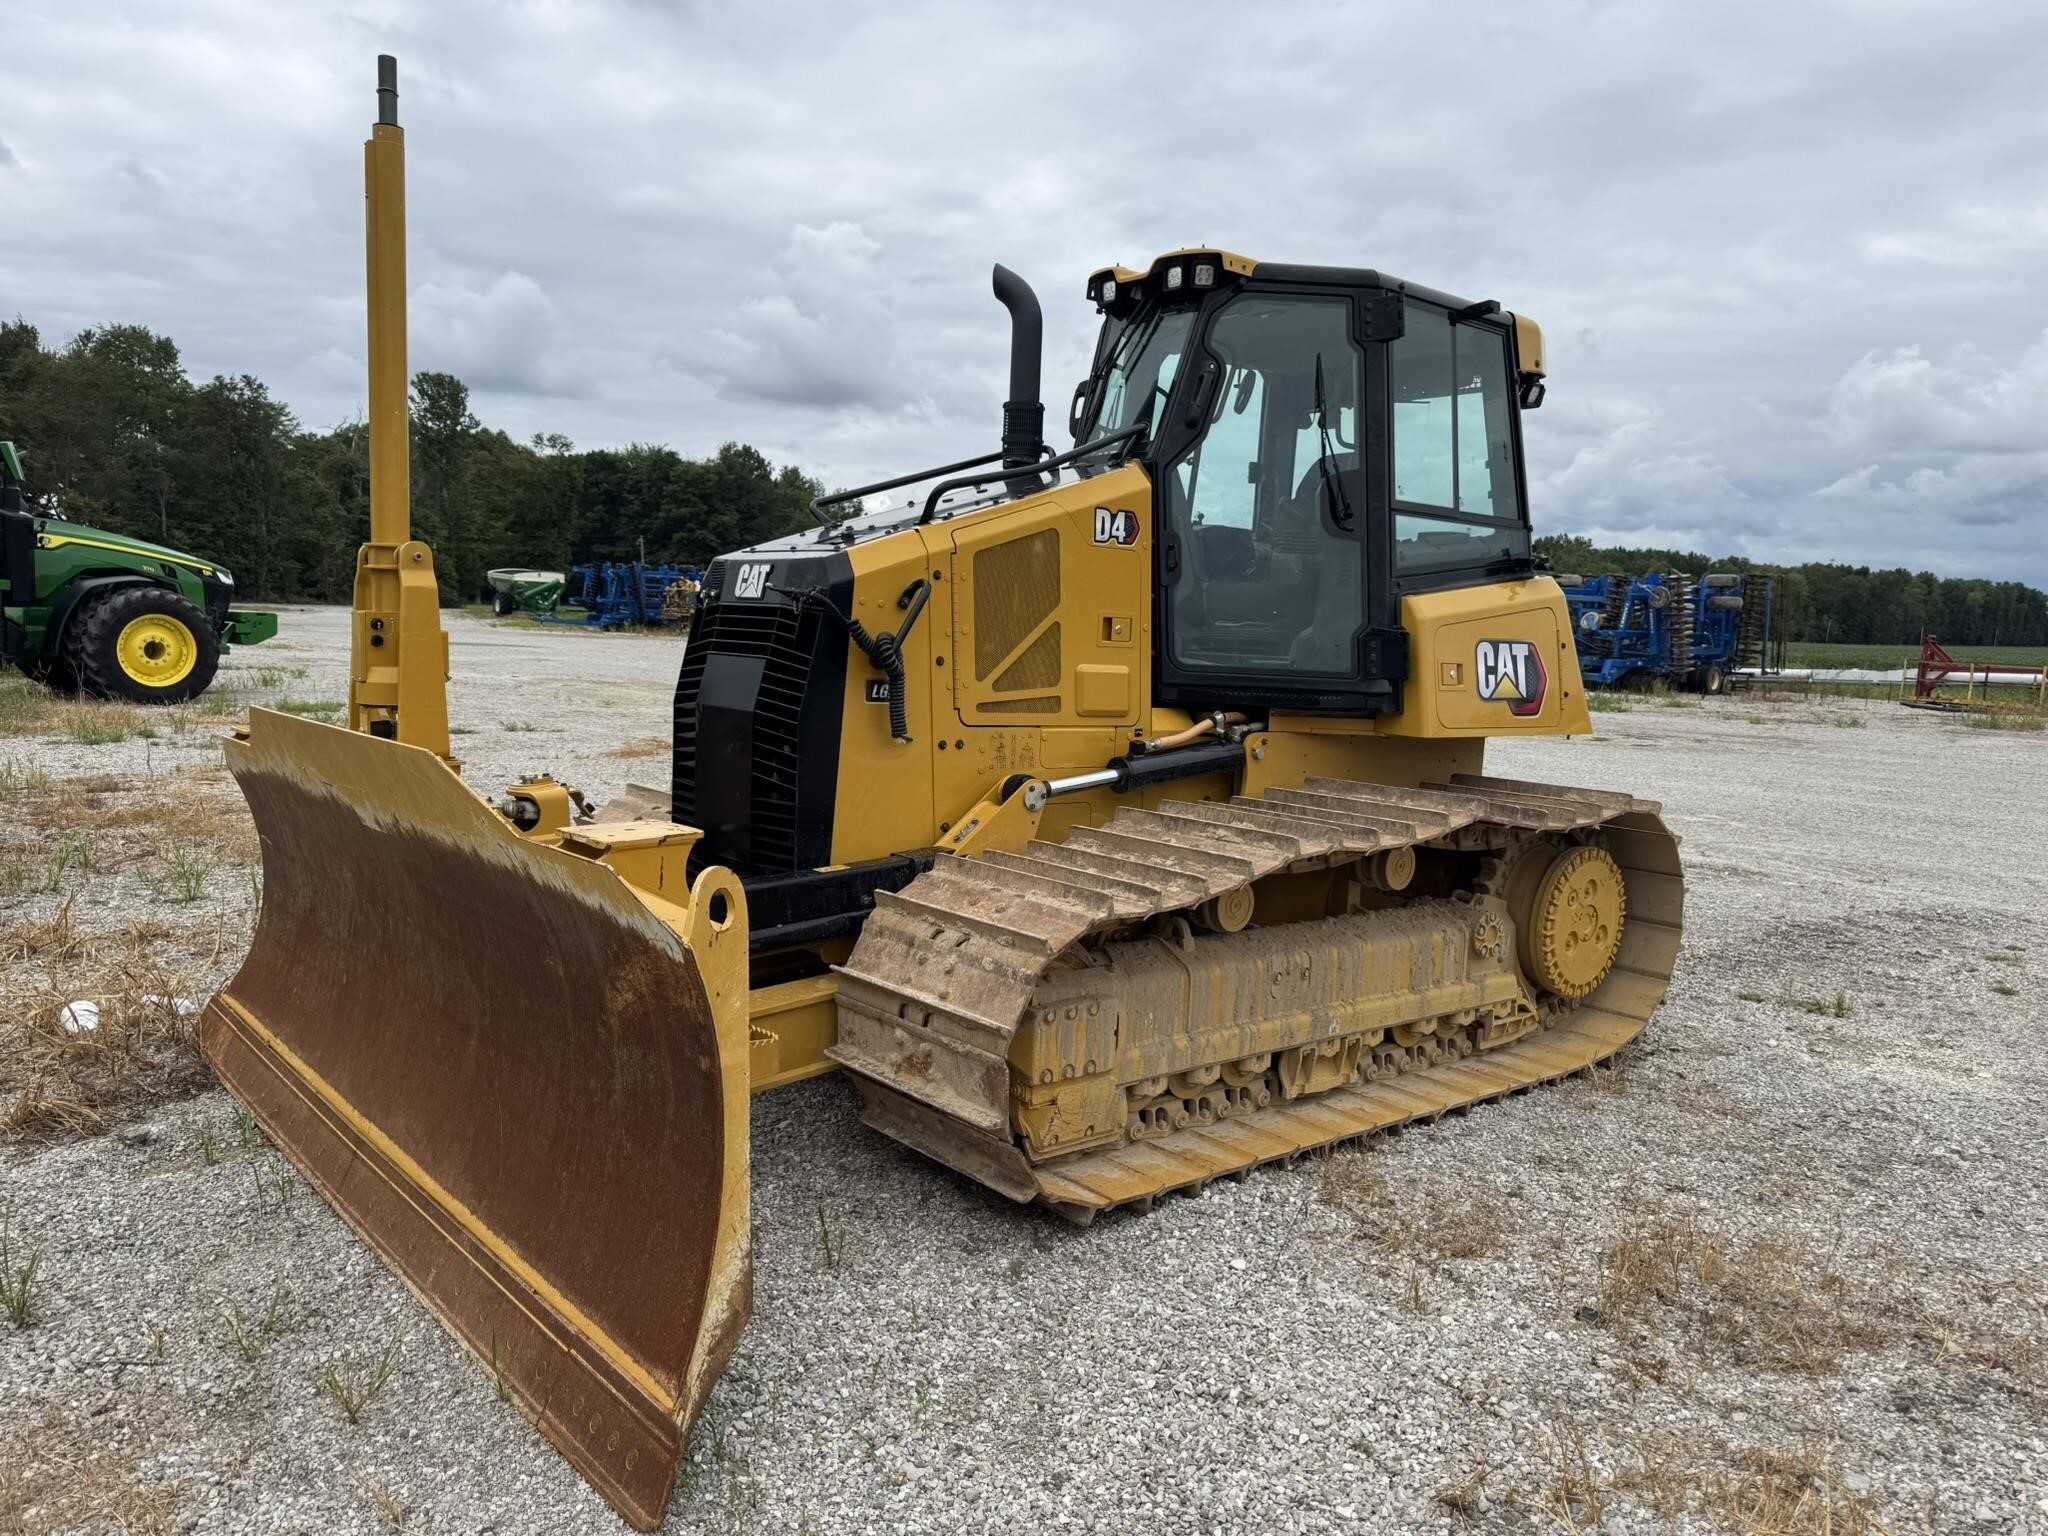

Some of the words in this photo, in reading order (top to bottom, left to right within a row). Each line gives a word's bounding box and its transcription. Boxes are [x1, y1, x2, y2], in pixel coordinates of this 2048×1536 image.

[1095, 508, 1126, 543] D4
[734, 563, 771, 598] CAT
[1476, 641, 1529, 699] CAT
[871, 683, 890, 698] LG
